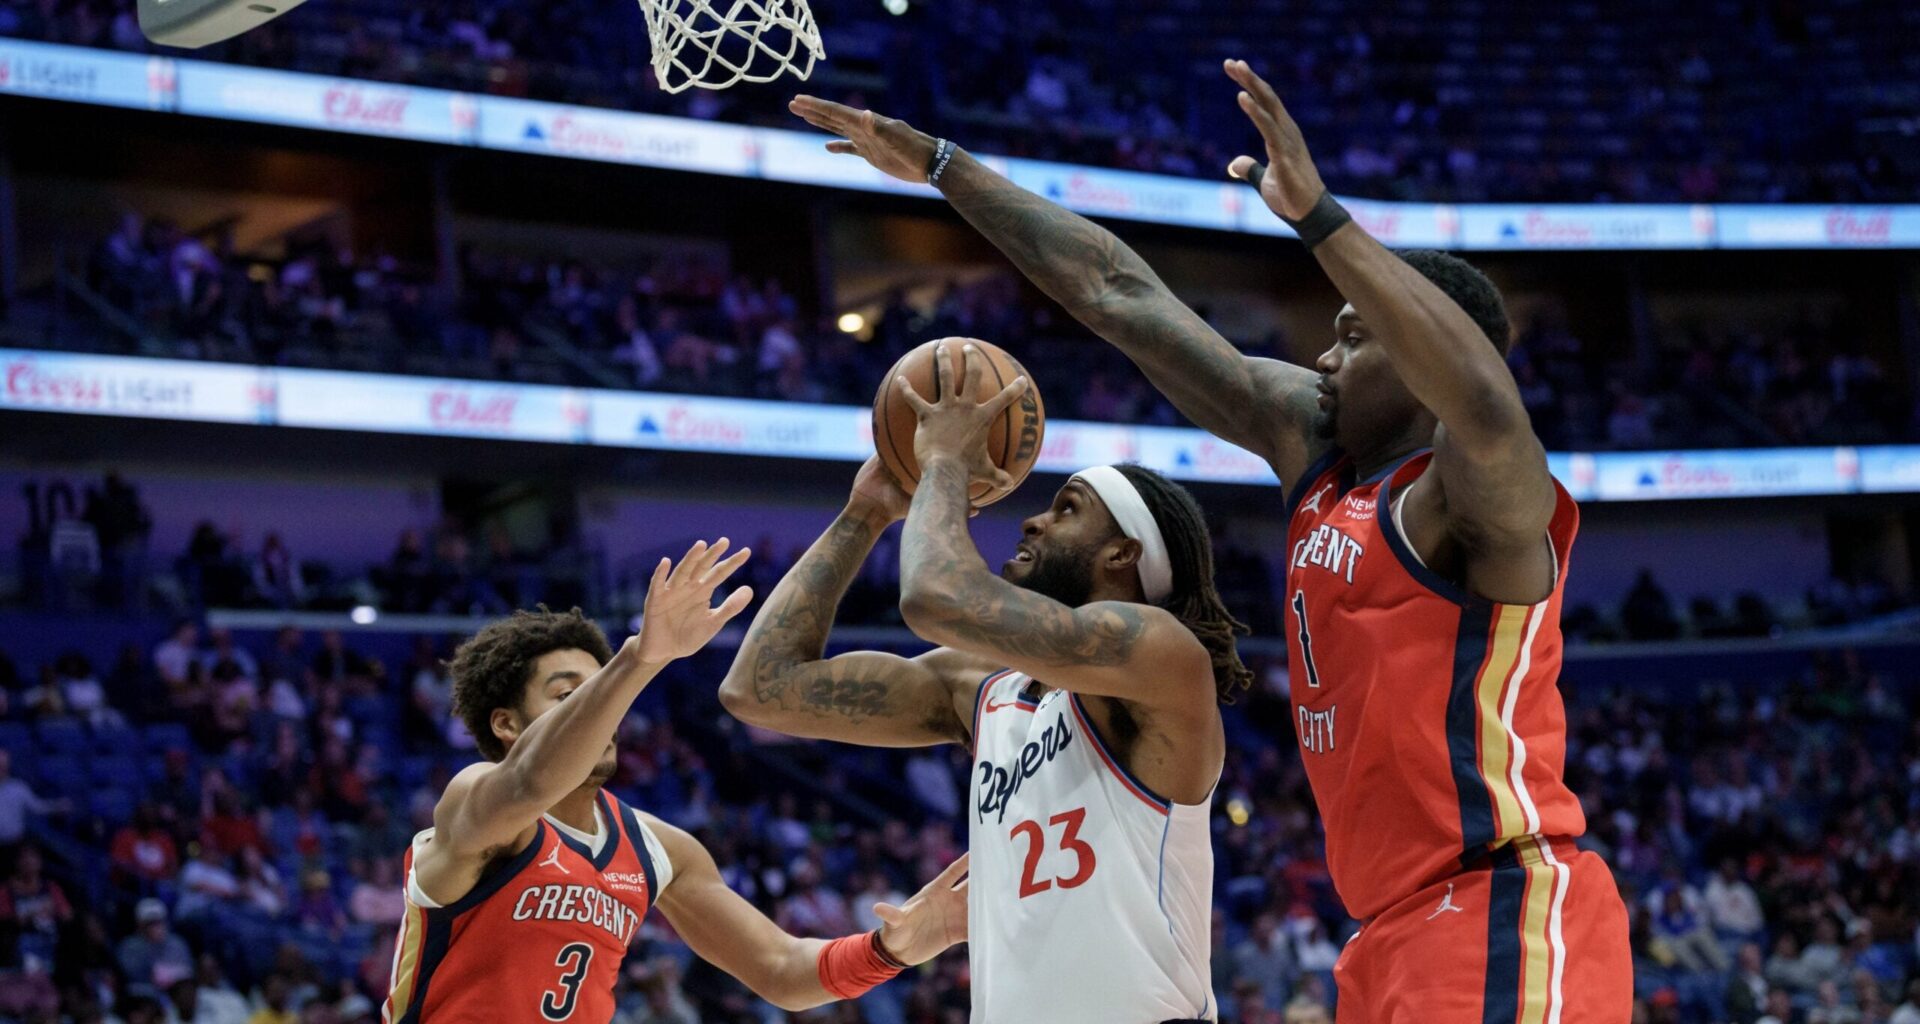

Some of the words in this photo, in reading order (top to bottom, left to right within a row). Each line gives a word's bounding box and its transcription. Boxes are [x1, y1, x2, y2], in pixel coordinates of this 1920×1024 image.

[1291, 588, 1321, 688] 1
[1298, 704, 1336, 753] CITY
[602, 872, 645, 884] NEWAGE
[1010, 806, 1096, 899] 23
[512, 884, 639, 948] CRESCENT
[540, 941, 594, 1022] 3
